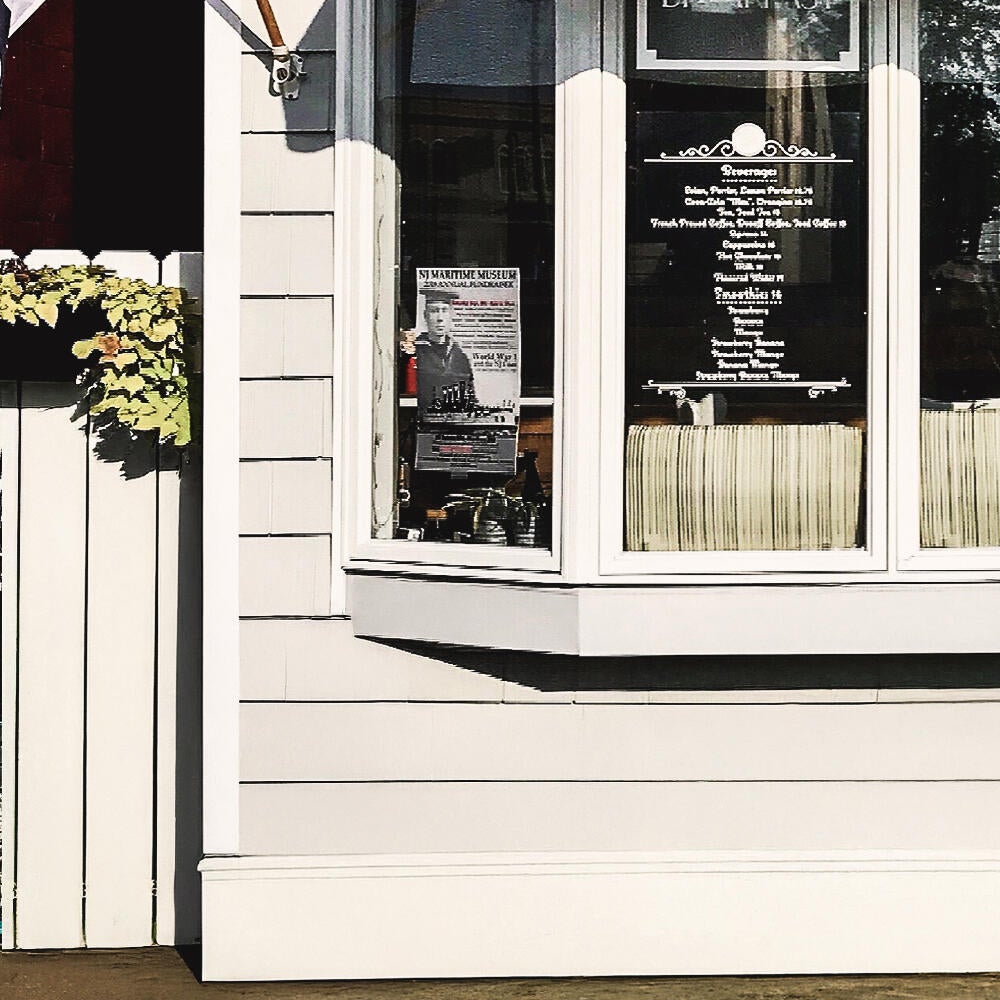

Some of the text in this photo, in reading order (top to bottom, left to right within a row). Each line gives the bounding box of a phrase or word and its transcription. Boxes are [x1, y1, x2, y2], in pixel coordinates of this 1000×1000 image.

[721, 165, 777, 179] Beverages
[432, 269, 476, 280] MARITIME
[478, 269, 517, 280] MUSEUM
